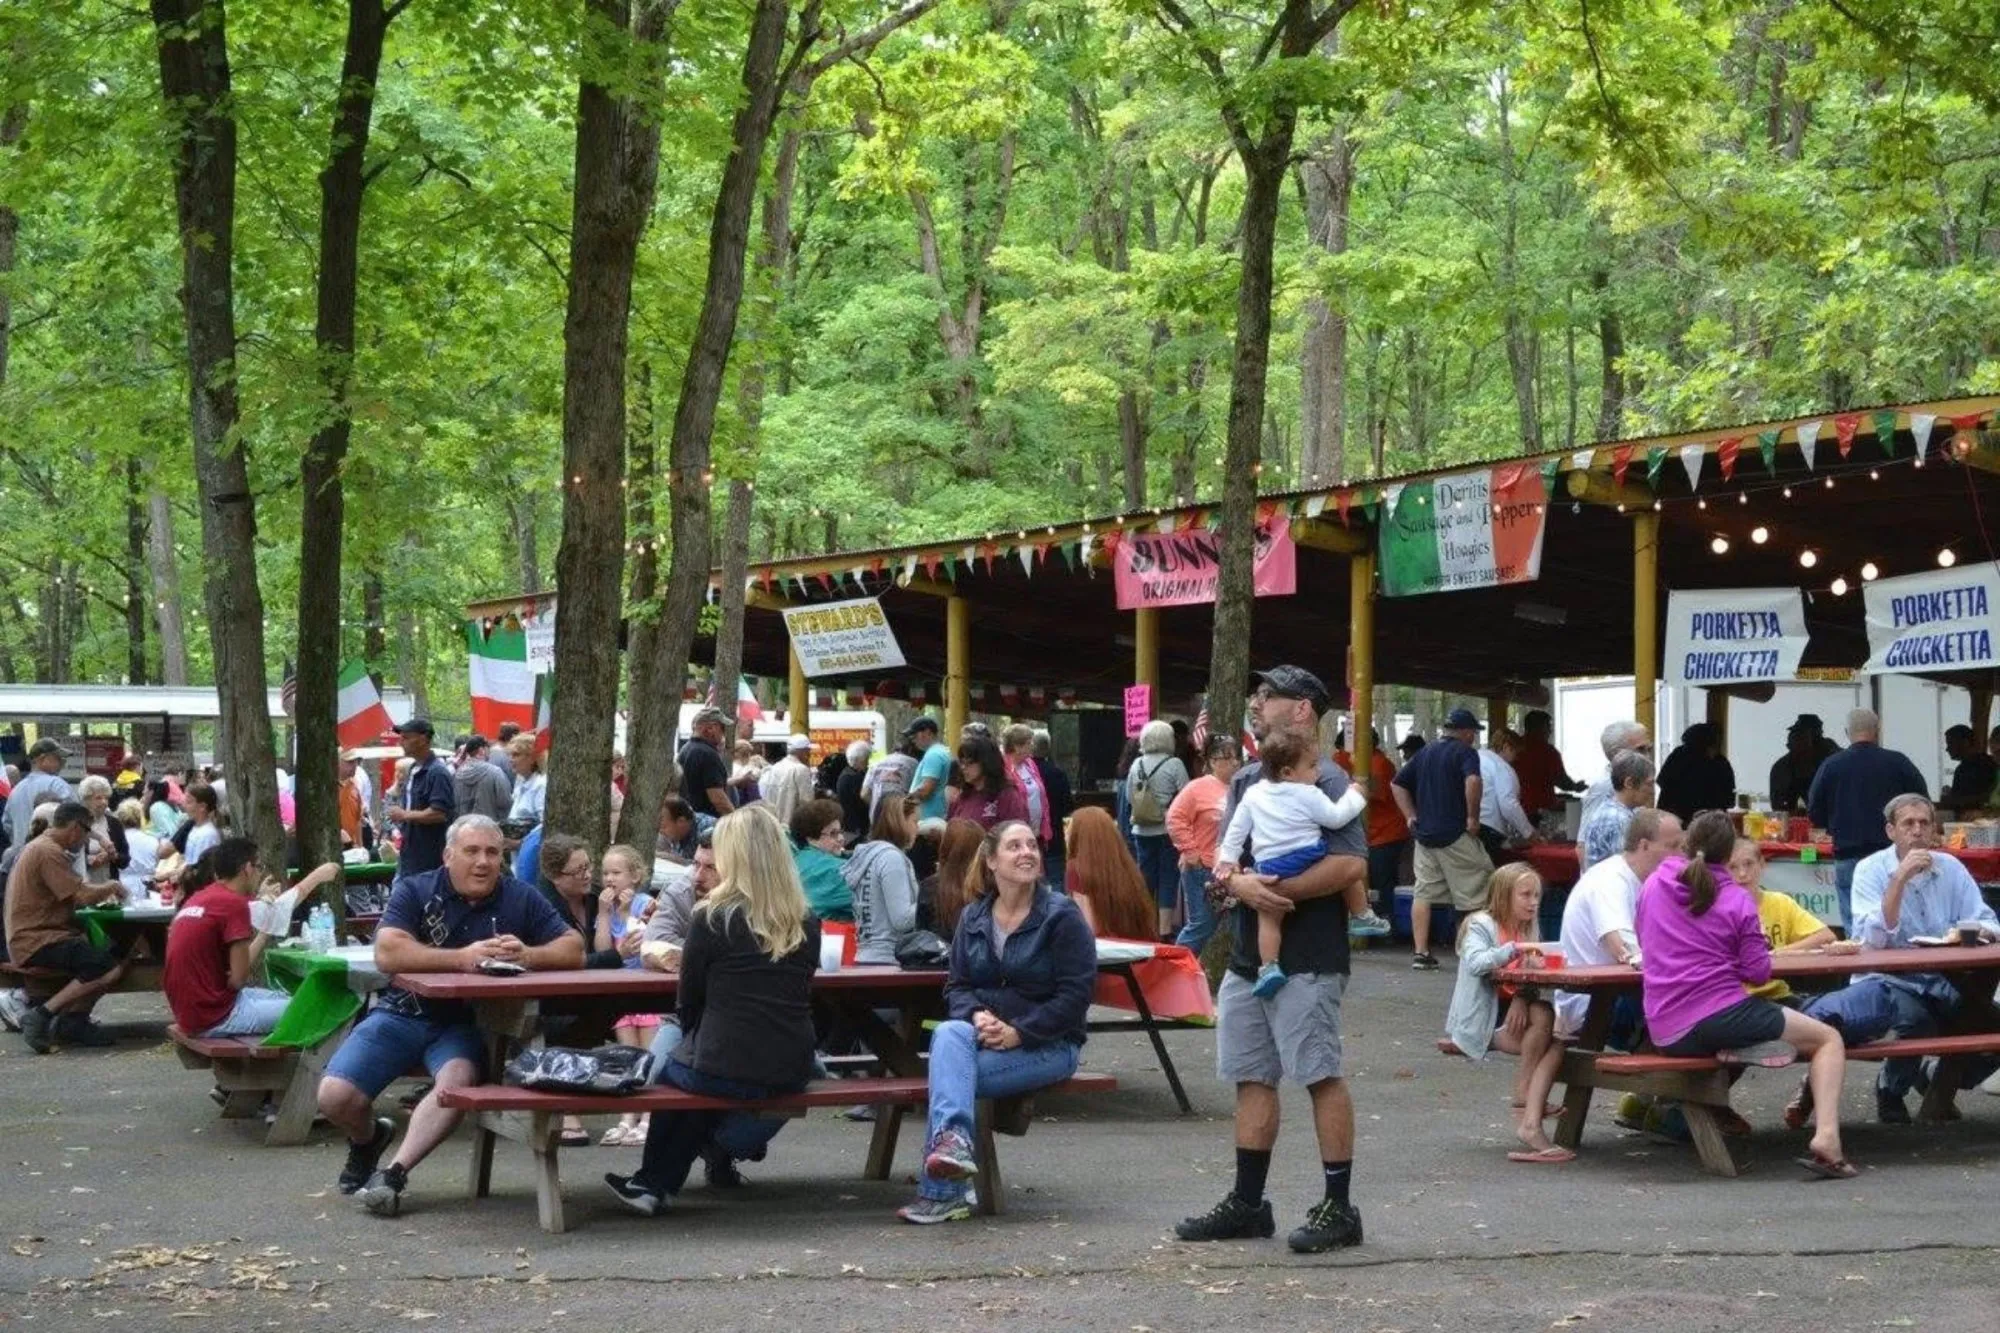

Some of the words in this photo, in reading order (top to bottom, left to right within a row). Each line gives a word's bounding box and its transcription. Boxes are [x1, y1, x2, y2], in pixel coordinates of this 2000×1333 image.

[1457, 513, 1474, 526] and
[1444, 539, 1490, 564] Hoagies
[1143, 577, 1201, 600] ORIGINAL
[1453, 569, 1477, 585] SWEET
[1892, 586, 1988, 627] PORKETTA
[1691, 611, 1783, 640] PORKETTA
[1885, 629, 1991, 667] CHICKETTA
[1684, 650, 1779, 680] CHICKETTA
